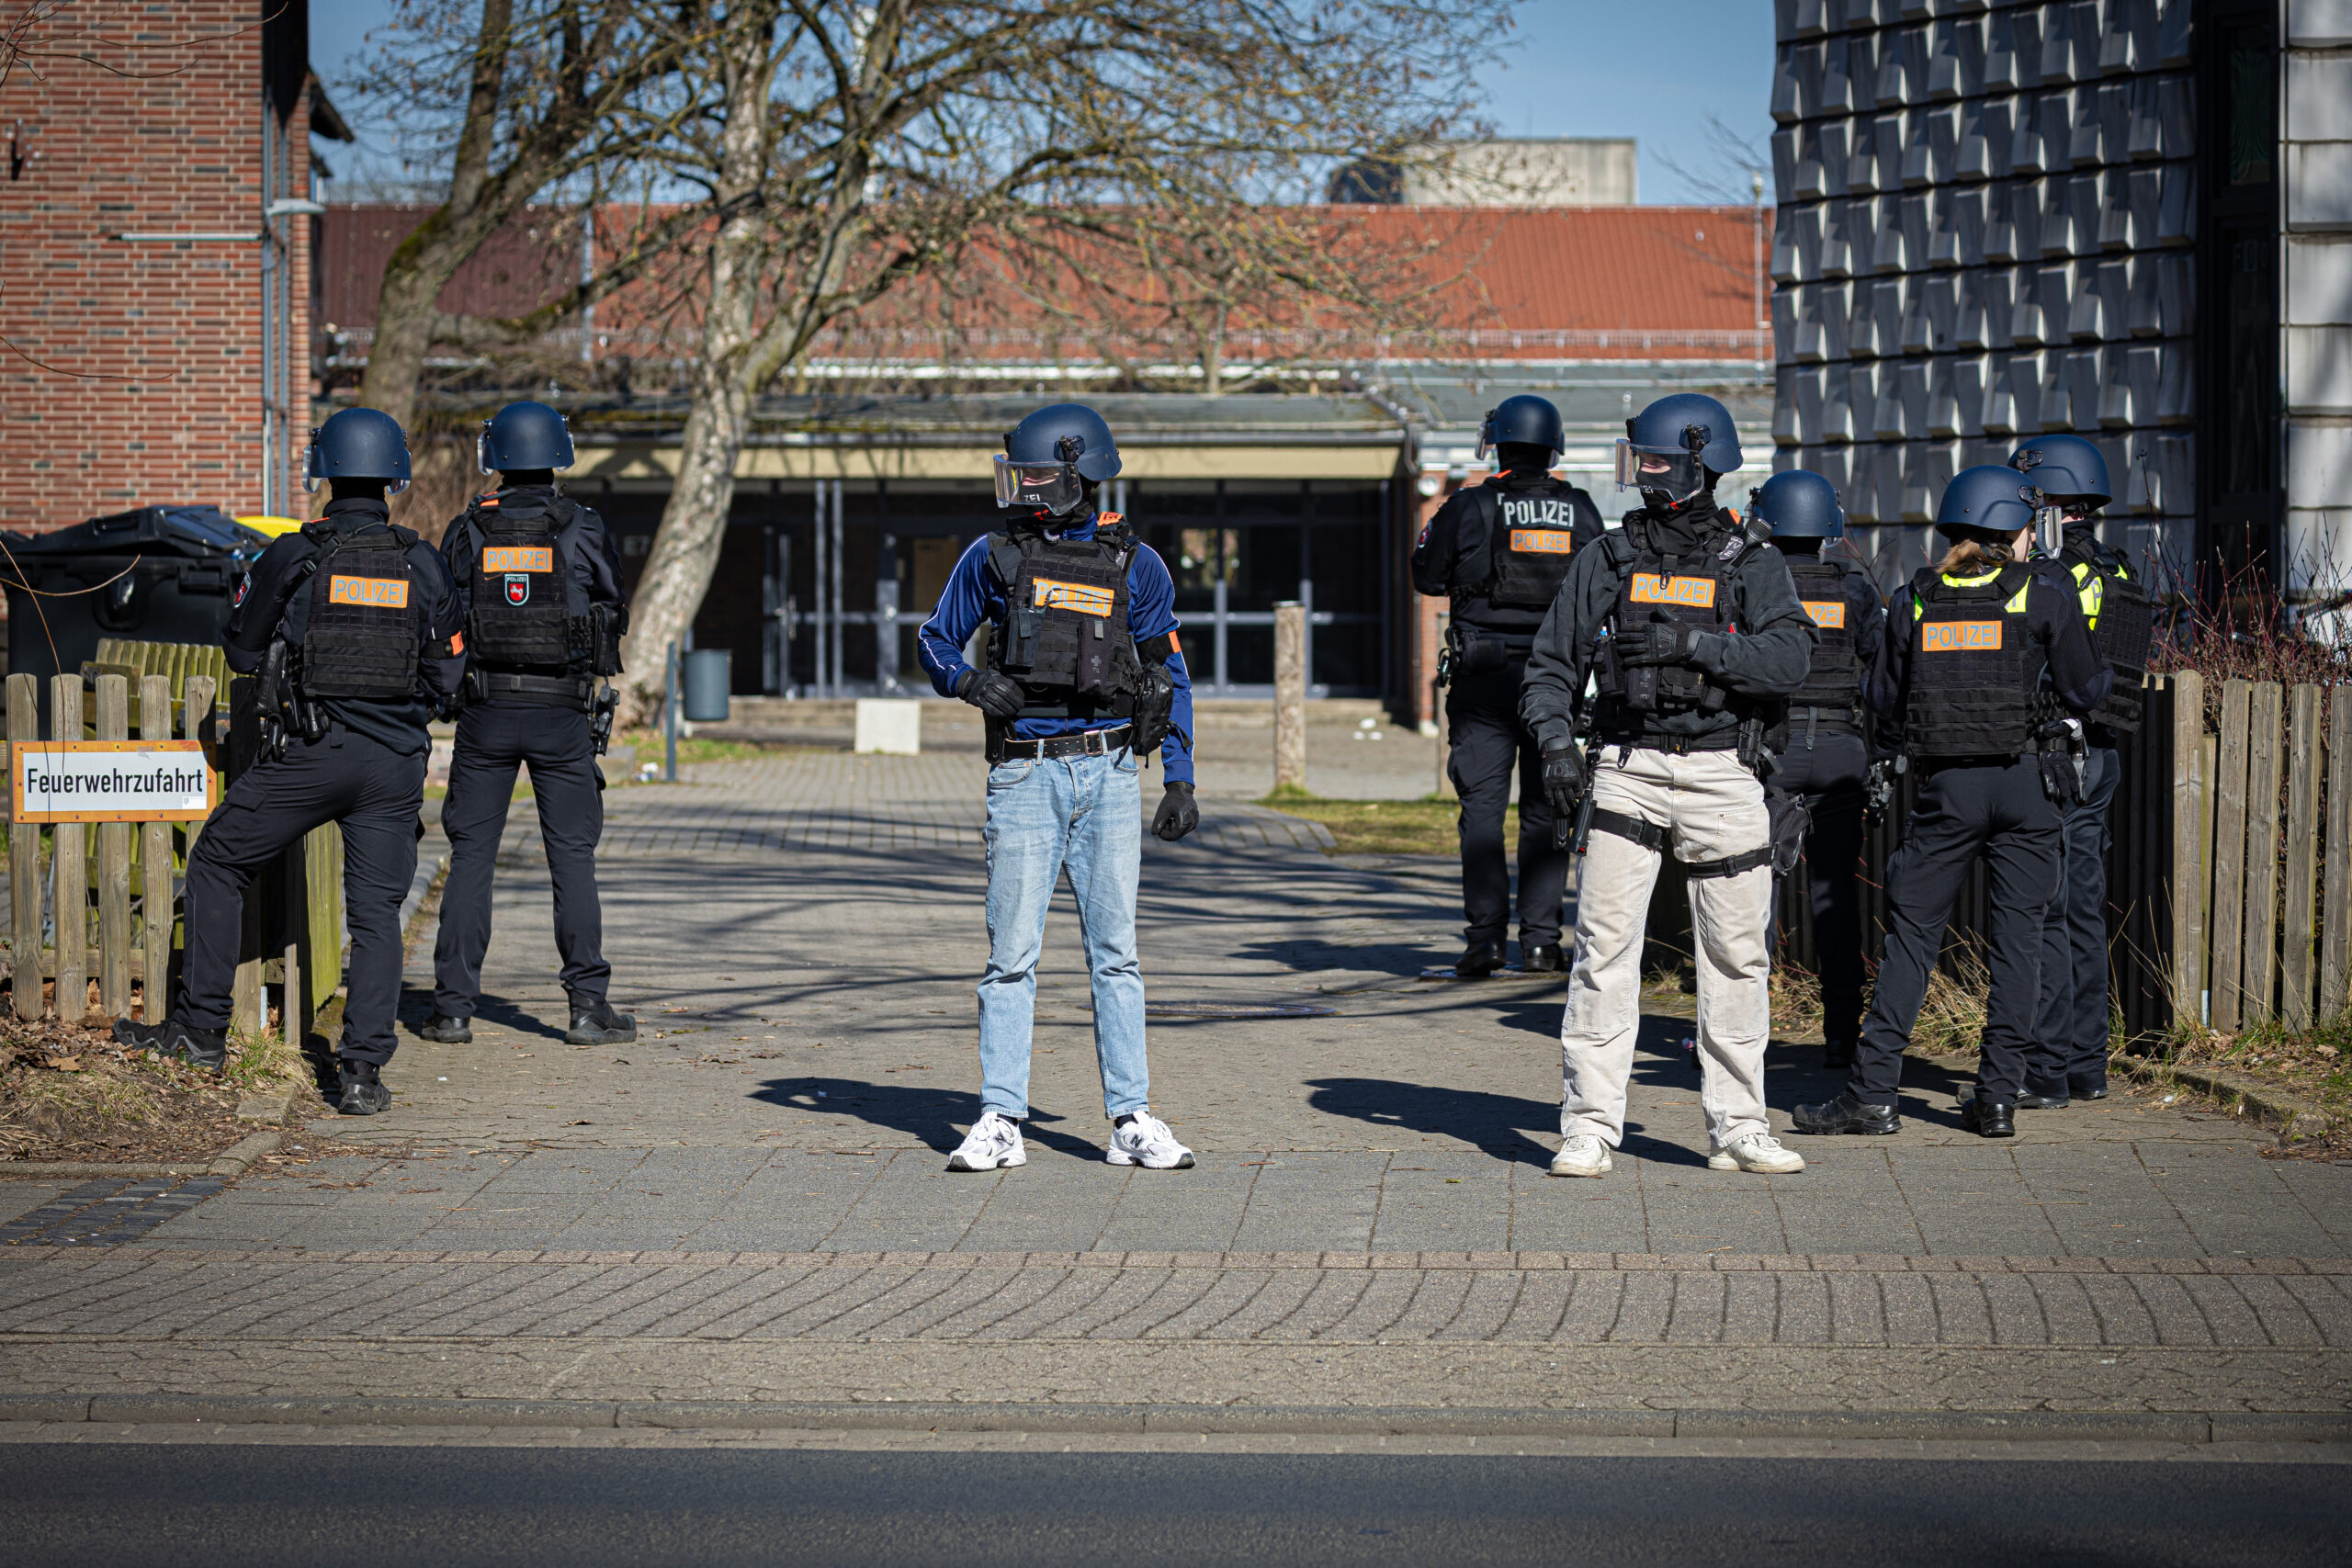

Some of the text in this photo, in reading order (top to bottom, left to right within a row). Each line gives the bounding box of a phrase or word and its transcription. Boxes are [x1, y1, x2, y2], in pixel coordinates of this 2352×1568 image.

[1504, 500, 1575, 527] POLIZEI
[1514, 533, 1567, 551] POLIZEI
[487, 550, 548, 570] POLIZEI
[334, 579, 403, 604] POLIZEI
[1035, 581, 1109, 614] POLIZEI
[1634, 577, 1711, 604] POLIZEI
[1811, 605, 1841, 625] IZEI
[1927, 625, 1996, 648] POLIZEI
[28, 768, 203, 794] Feuerwehrzufahrt
